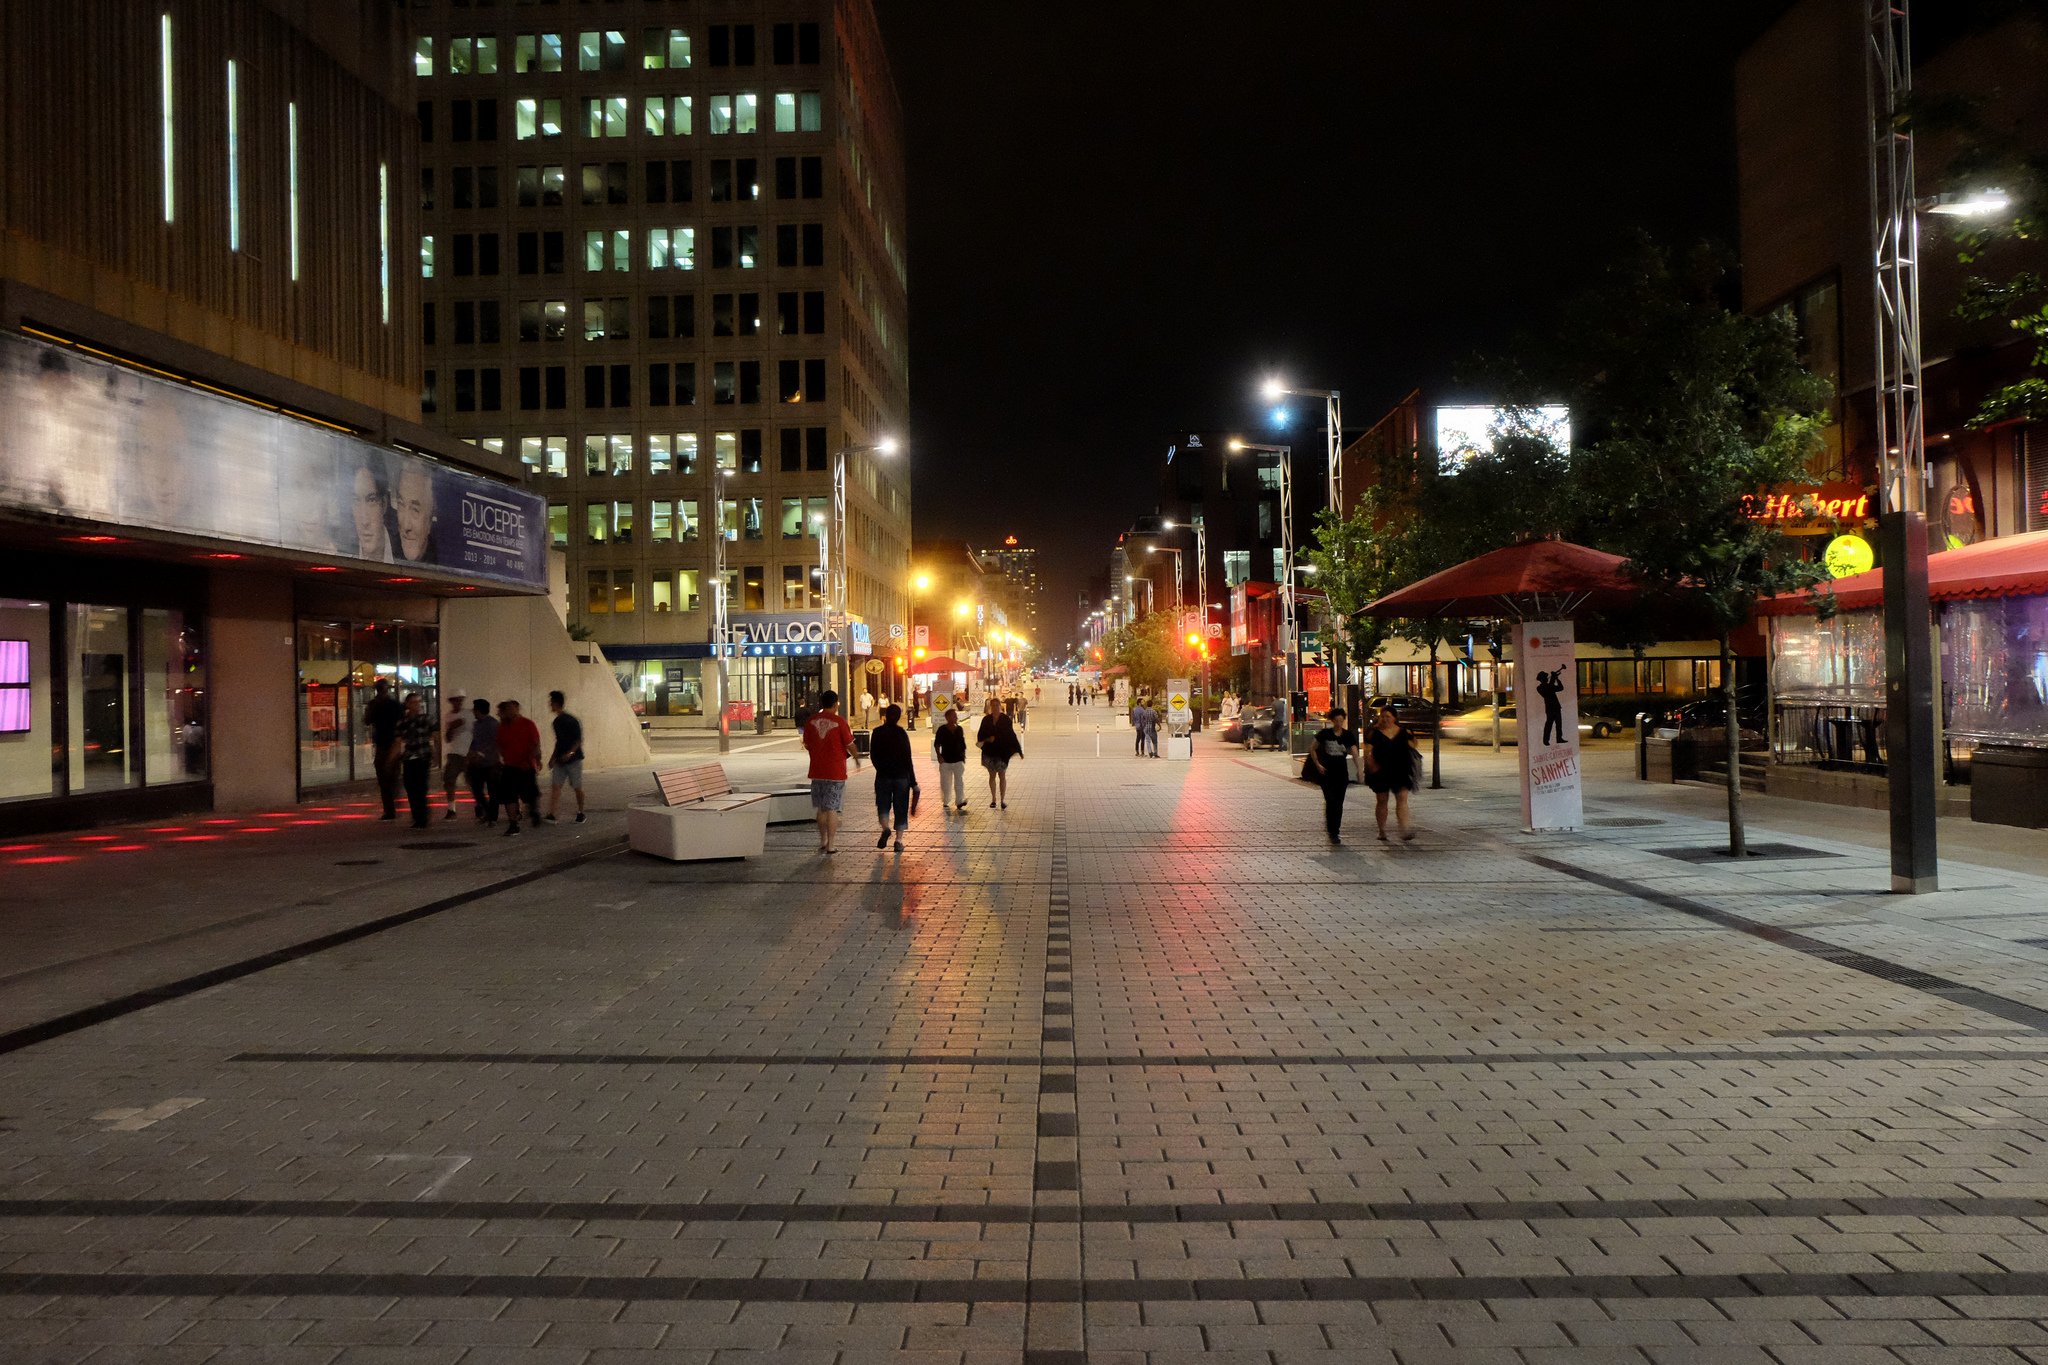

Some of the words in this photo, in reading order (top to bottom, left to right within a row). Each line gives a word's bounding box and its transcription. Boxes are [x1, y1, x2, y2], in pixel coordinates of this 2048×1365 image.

[462, 499, 525, 538] DUCEPPE
[464, 551, 478, 562] 2013
[483, 555, 497, 566] 2014
